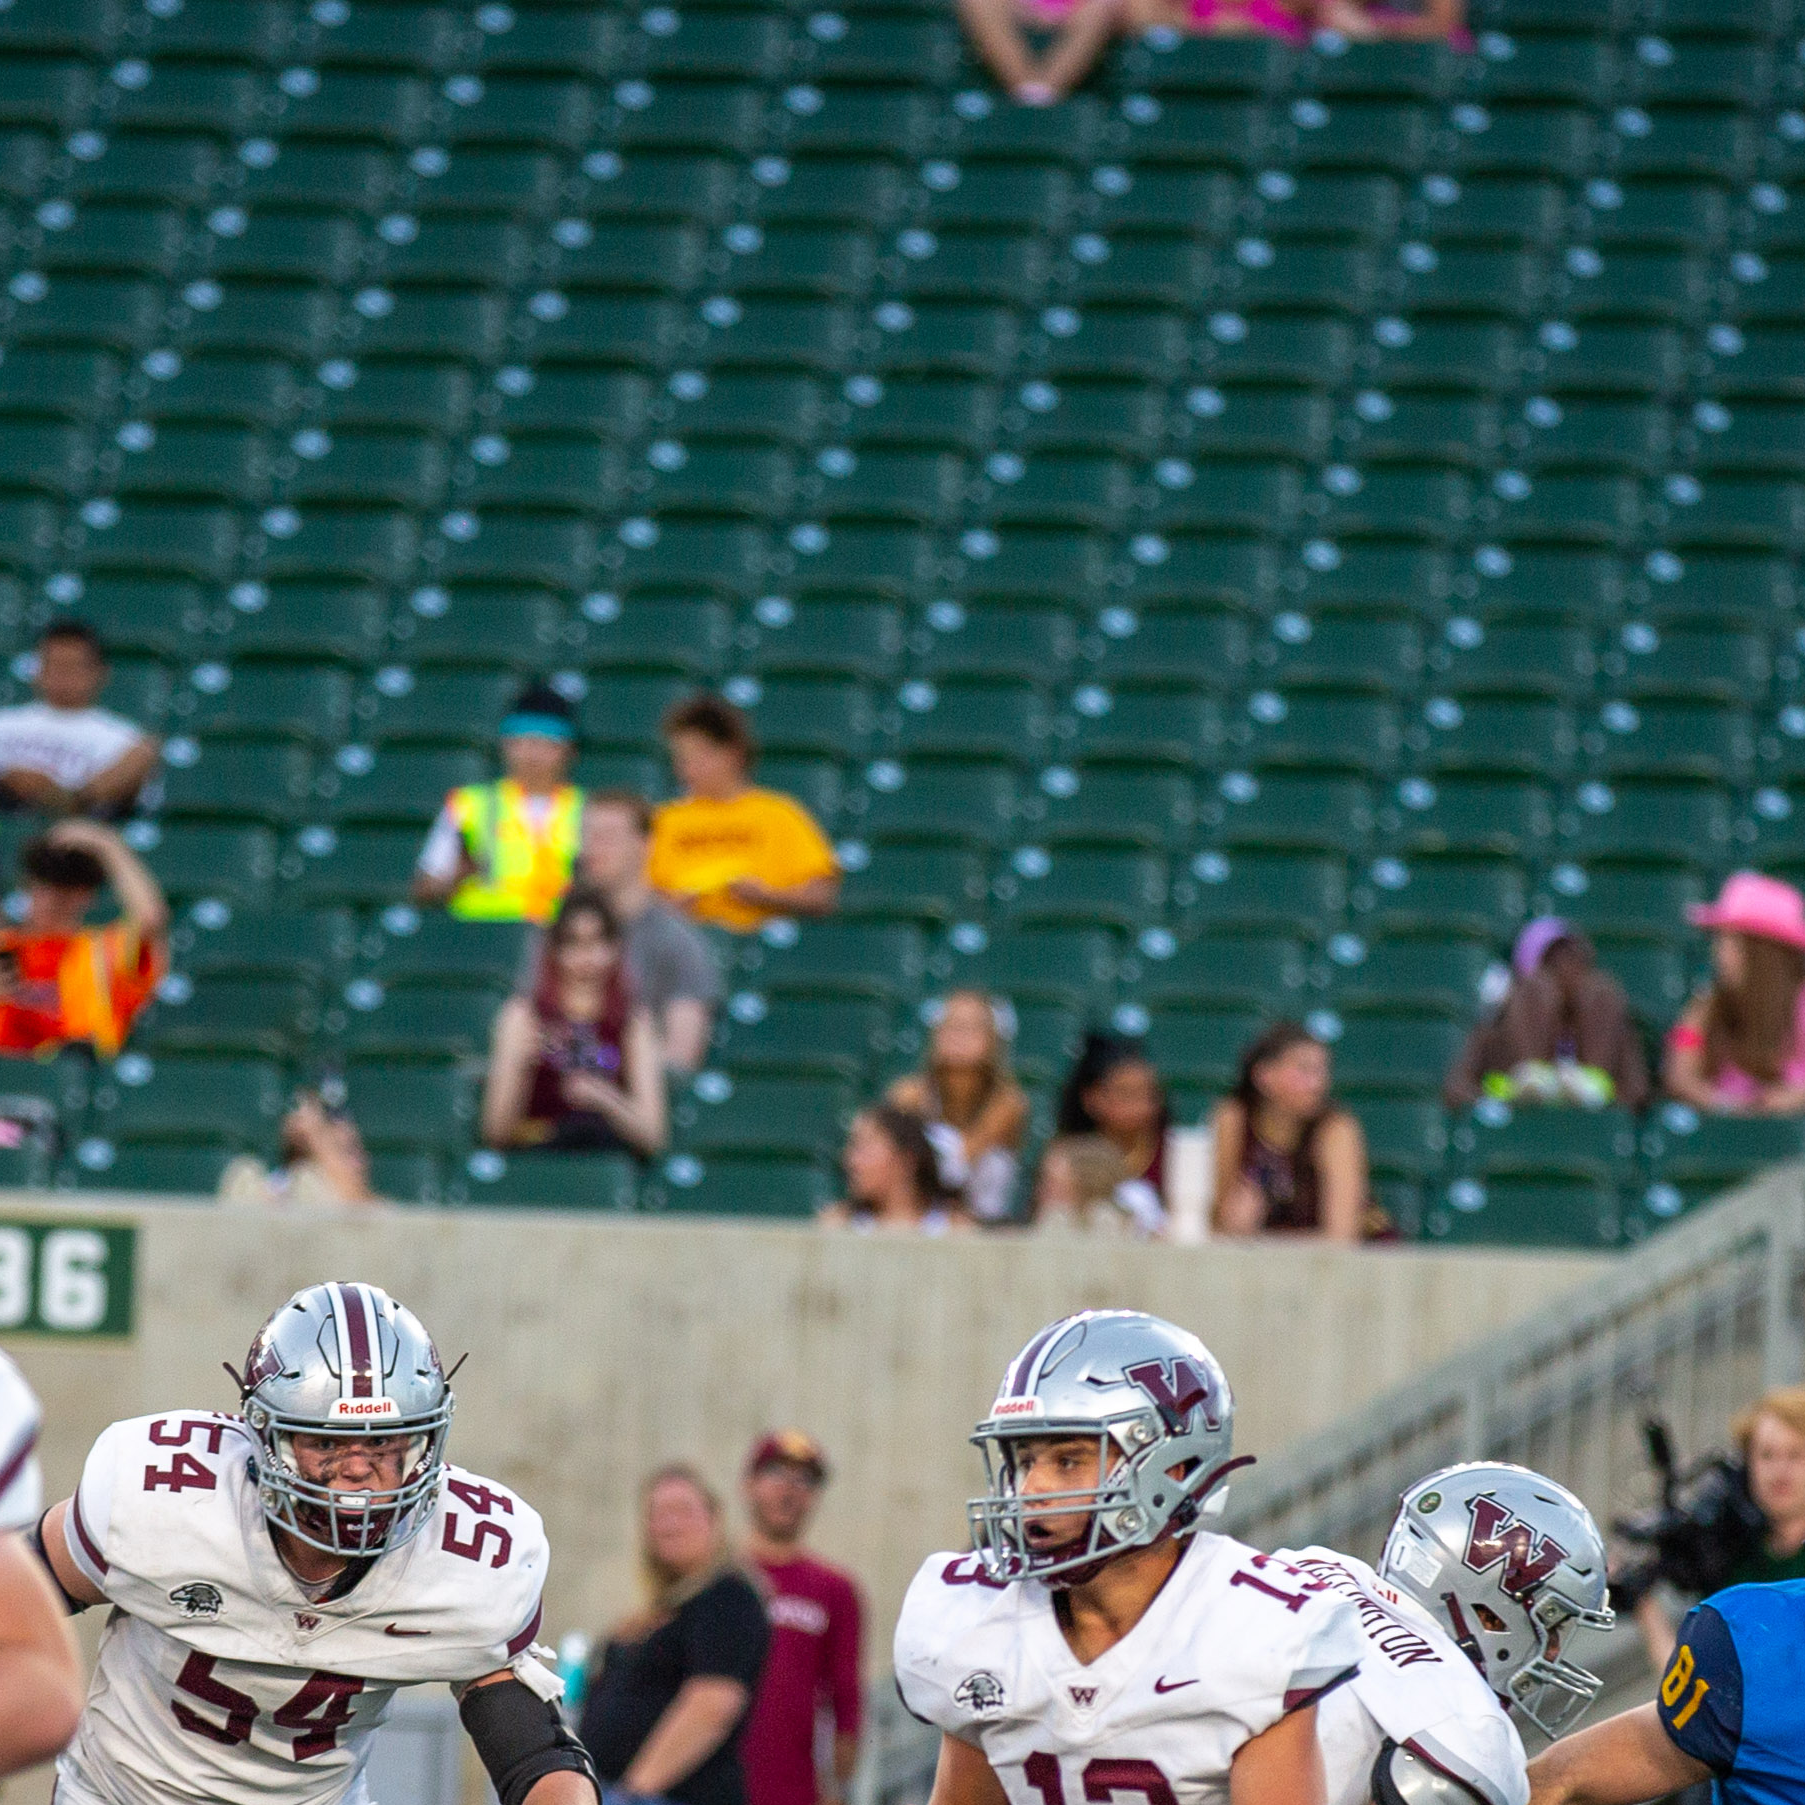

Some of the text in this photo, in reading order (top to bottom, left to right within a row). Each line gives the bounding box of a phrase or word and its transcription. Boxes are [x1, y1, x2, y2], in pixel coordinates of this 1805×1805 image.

[339, 1402, 391, 1415] Riddell
[1121, 1356, 1222, 1437] W
[143, 1419, 223, 1493] 54
[441, 1478, 514, 1569] 54
[1461, 1493, 1571, 1599] W
[295, 1613, 322, 1631] W
[170, 1649, 366, 1762] 54
[1069, 1686, 1098, 1706] W
[1661, 1645, 1709, 1730] 81
